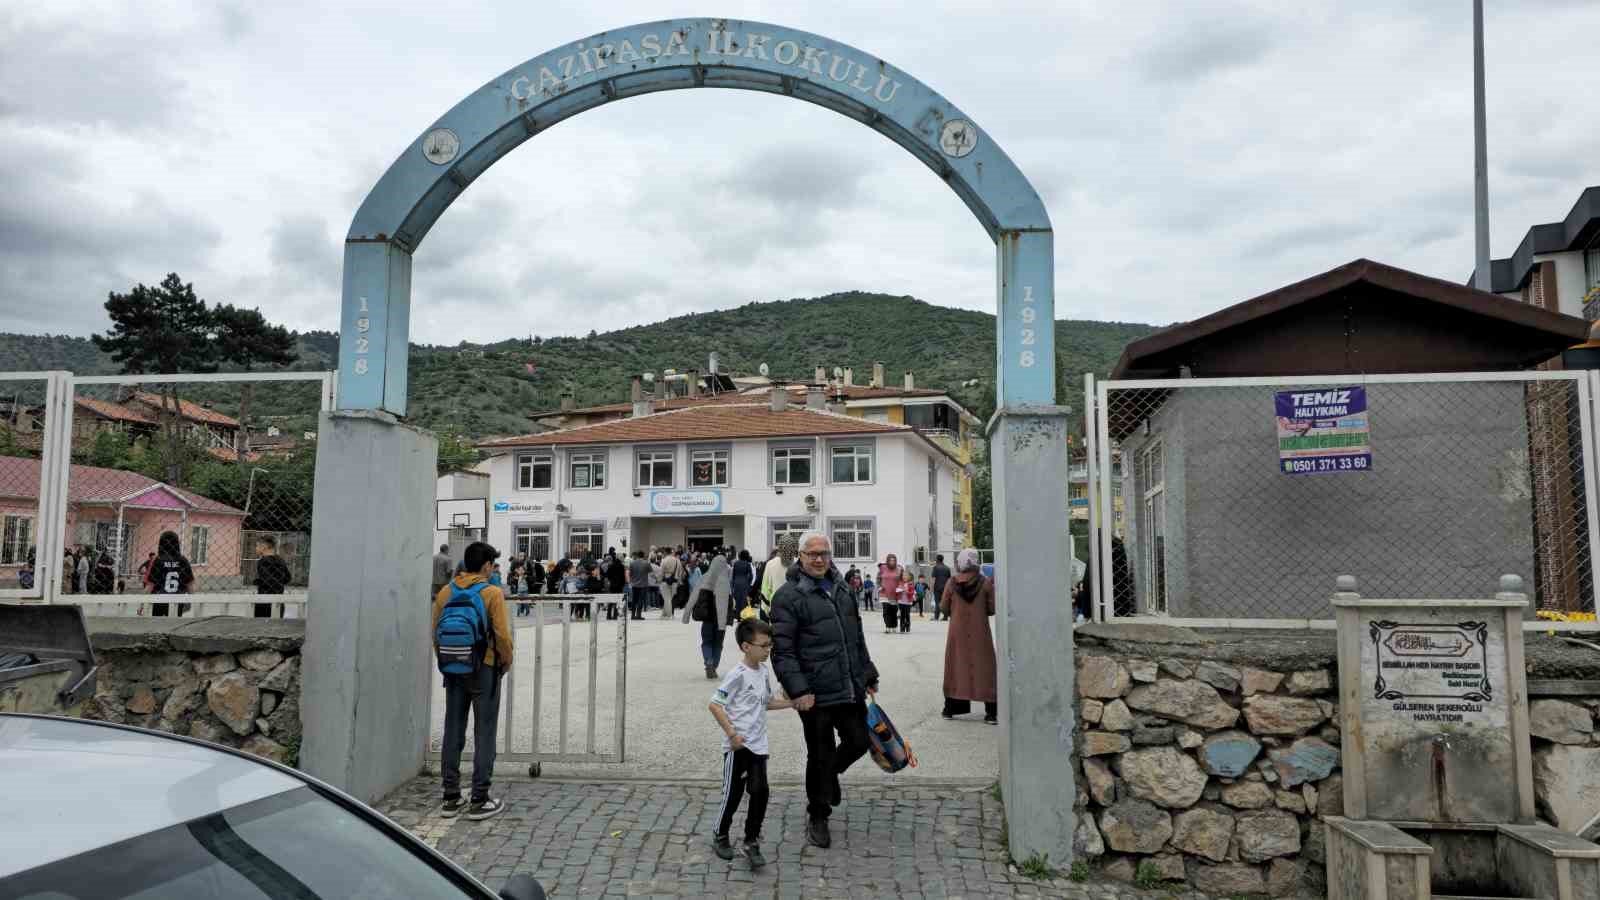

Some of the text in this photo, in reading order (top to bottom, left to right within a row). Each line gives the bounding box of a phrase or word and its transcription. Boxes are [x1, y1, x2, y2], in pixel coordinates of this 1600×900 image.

[706, 19, 901, 102] İLKOKULU
[353, 296, 368, 376] 1928
[1020, 286, 1035, 368] 1928
[1291, 388, 1351, 406] TEMİZ
[1295, 405, 1348, 418] HALI YIKAMA
[1294, 460, 1316, 472] 0501
[1319, 459, 1337, 471] 371
[1340, 458, 1352, 470] 33
[164, 571, 180, 593] 6
